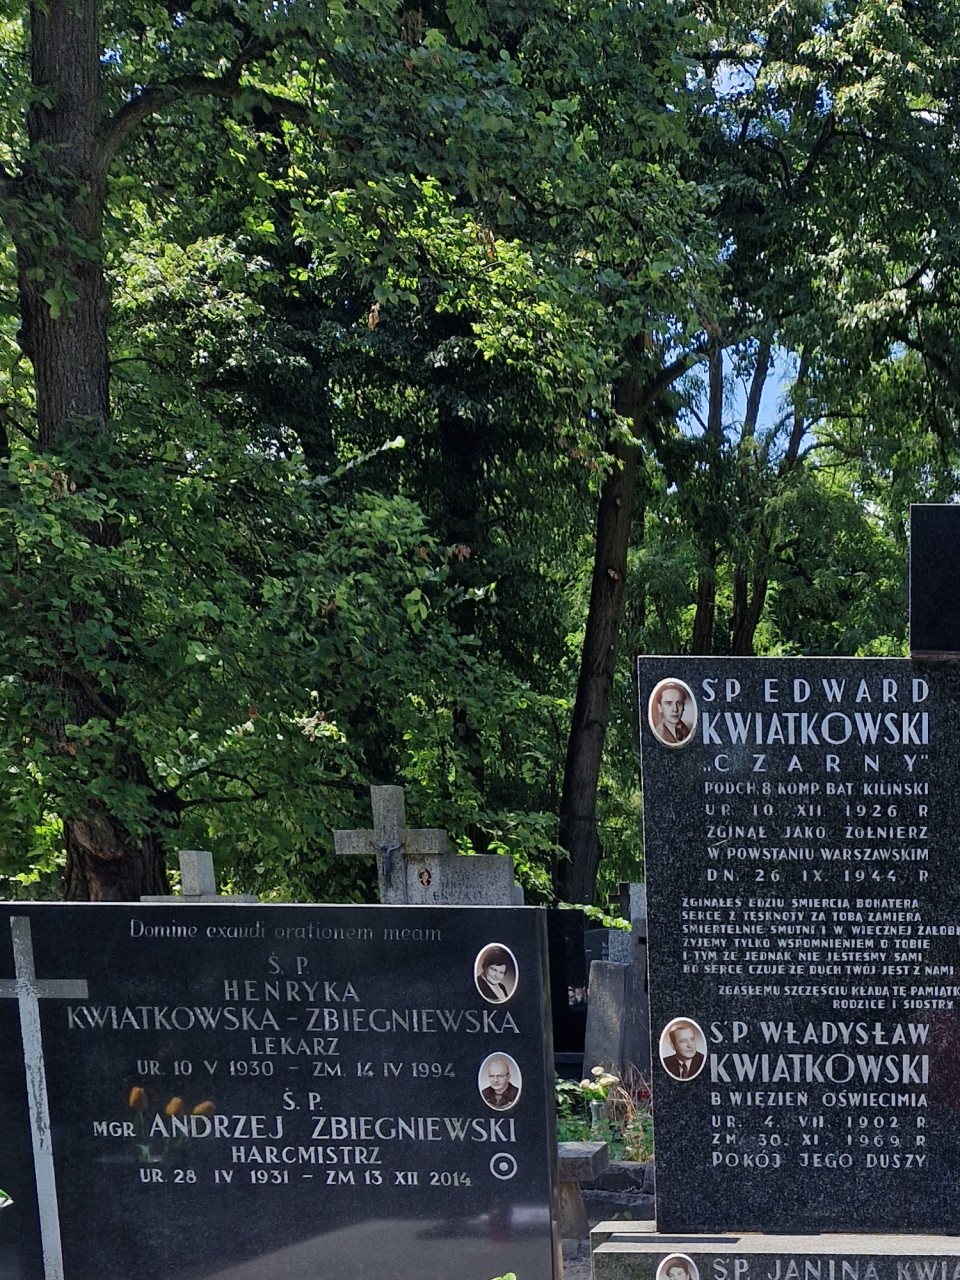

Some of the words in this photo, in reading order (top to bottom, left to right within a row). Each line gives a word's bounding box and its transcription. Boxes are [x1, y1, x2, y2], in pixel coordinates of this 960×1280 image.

[764, 678, 929, 703] EDWARD
[702, 712, 929, 745] KWIATKOWSKI
[846, 804, 897, 818] 1926
[783, 825, 826, 840] JAKO
[845, 823, 929, 839] ŻOŁNIERZ
[727, 847, 814, 861] POWSTANIU
[820, 847, 929, 861] WARSZAWSKIM
[844, 869, 897, 882] 1944
[130, 918, 198, 941] Domine
[206, 918, 266, 941] exaudi
[274, 921, 374, 941] orationem
[384, 926, 442, 942] meam
[223, 980, 361, 1003] HENRYKA
[67, 1005, 279, 1031] KWIATKOWSKA
[305, 1007, 521, 1035] ZBIEGNIEWSKA
[760, 1021, 930, 1046] WŁADYSŁAW
[251, 1036, 340, 1056] LEKARZ
[174, 1060, 192, 1077] 10
[229, 1060, 274, 1078] 1930
[356, 1060, 375, 1078] 14
[383, 1060, 403, 1078] IV
[411, 1061, 456, 1079] 1994
[710, 1053, 930, 1084] KWIATKOWSKI
[308, 1093, 323, 1111] P.
[93, 1121, 137, 1137] MGR
[149, 1113, 284, 1140] ANDRZEJ
[311, 1115, 517, 1142] ZBIEGNIEWSKI
[847, 1115, 899, 1128] 1902
[847, 1134, 900, 1147] 1969
[231, 1146, 382, 1166] HARCMISTRZ
[712, 1151, 781, 1169] POKÓJ
[799, 1153, 853, 1168] JEGO
[866, 1154, 926, 1169] DUSZY
[174, 1168, 197, 1184] 28
[214, 1169, 233, 1184] IV
[250, 1169, 289, 1185] 1931
[326, 1169, 355, 1186] ZM
[364, 1169, 382, 1186] 13
[395, 1170, 418, 1186] XII
[429, 1169, 471, 1187] 2014
